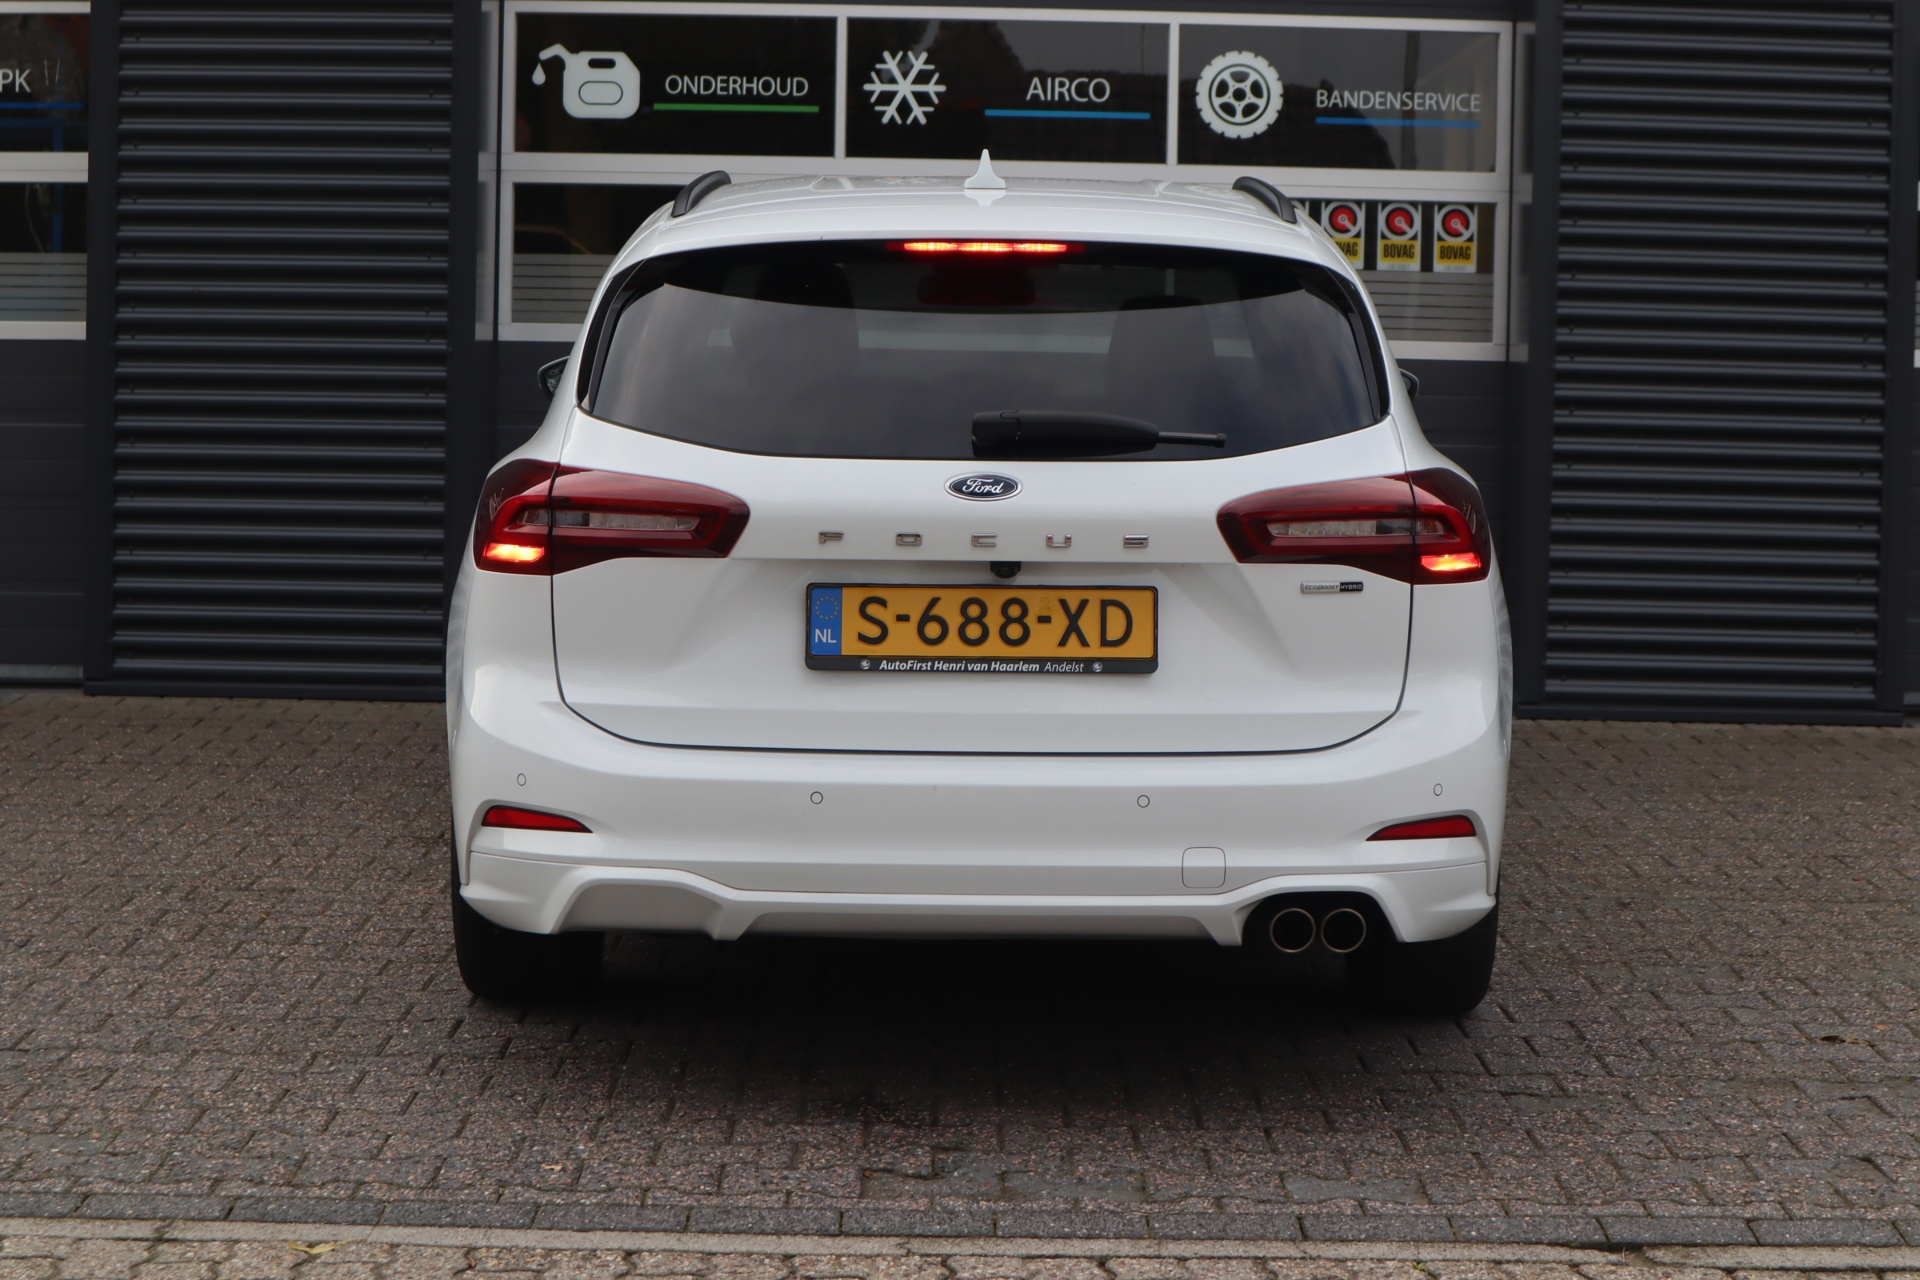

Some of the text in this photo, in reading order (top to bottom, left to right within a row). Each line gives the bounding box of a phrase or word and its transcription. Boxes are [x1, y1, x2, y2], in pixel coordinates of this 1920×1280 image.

[665, 75, 809, 97] ONDERHOUD
[1026, 76, 1111, 103] AIRCO
[1316, 89, 1481, 112] BANDENSERVICE
[1335, 240, 1359, 257] VAG
[1383, 243, 1415, 259] BOVAG
[1439, 245, 1471, 261] BOVAG
[962, 478, 1005, 493] Ford
[819, 531, 1149, 548] FOCUS
[857, 596, 1133, 648] S-688-XD
[815, 628, 837, 643] NL
[879, 660, 1085, 672] AutoFirst Henri van Haarlem Andelst
